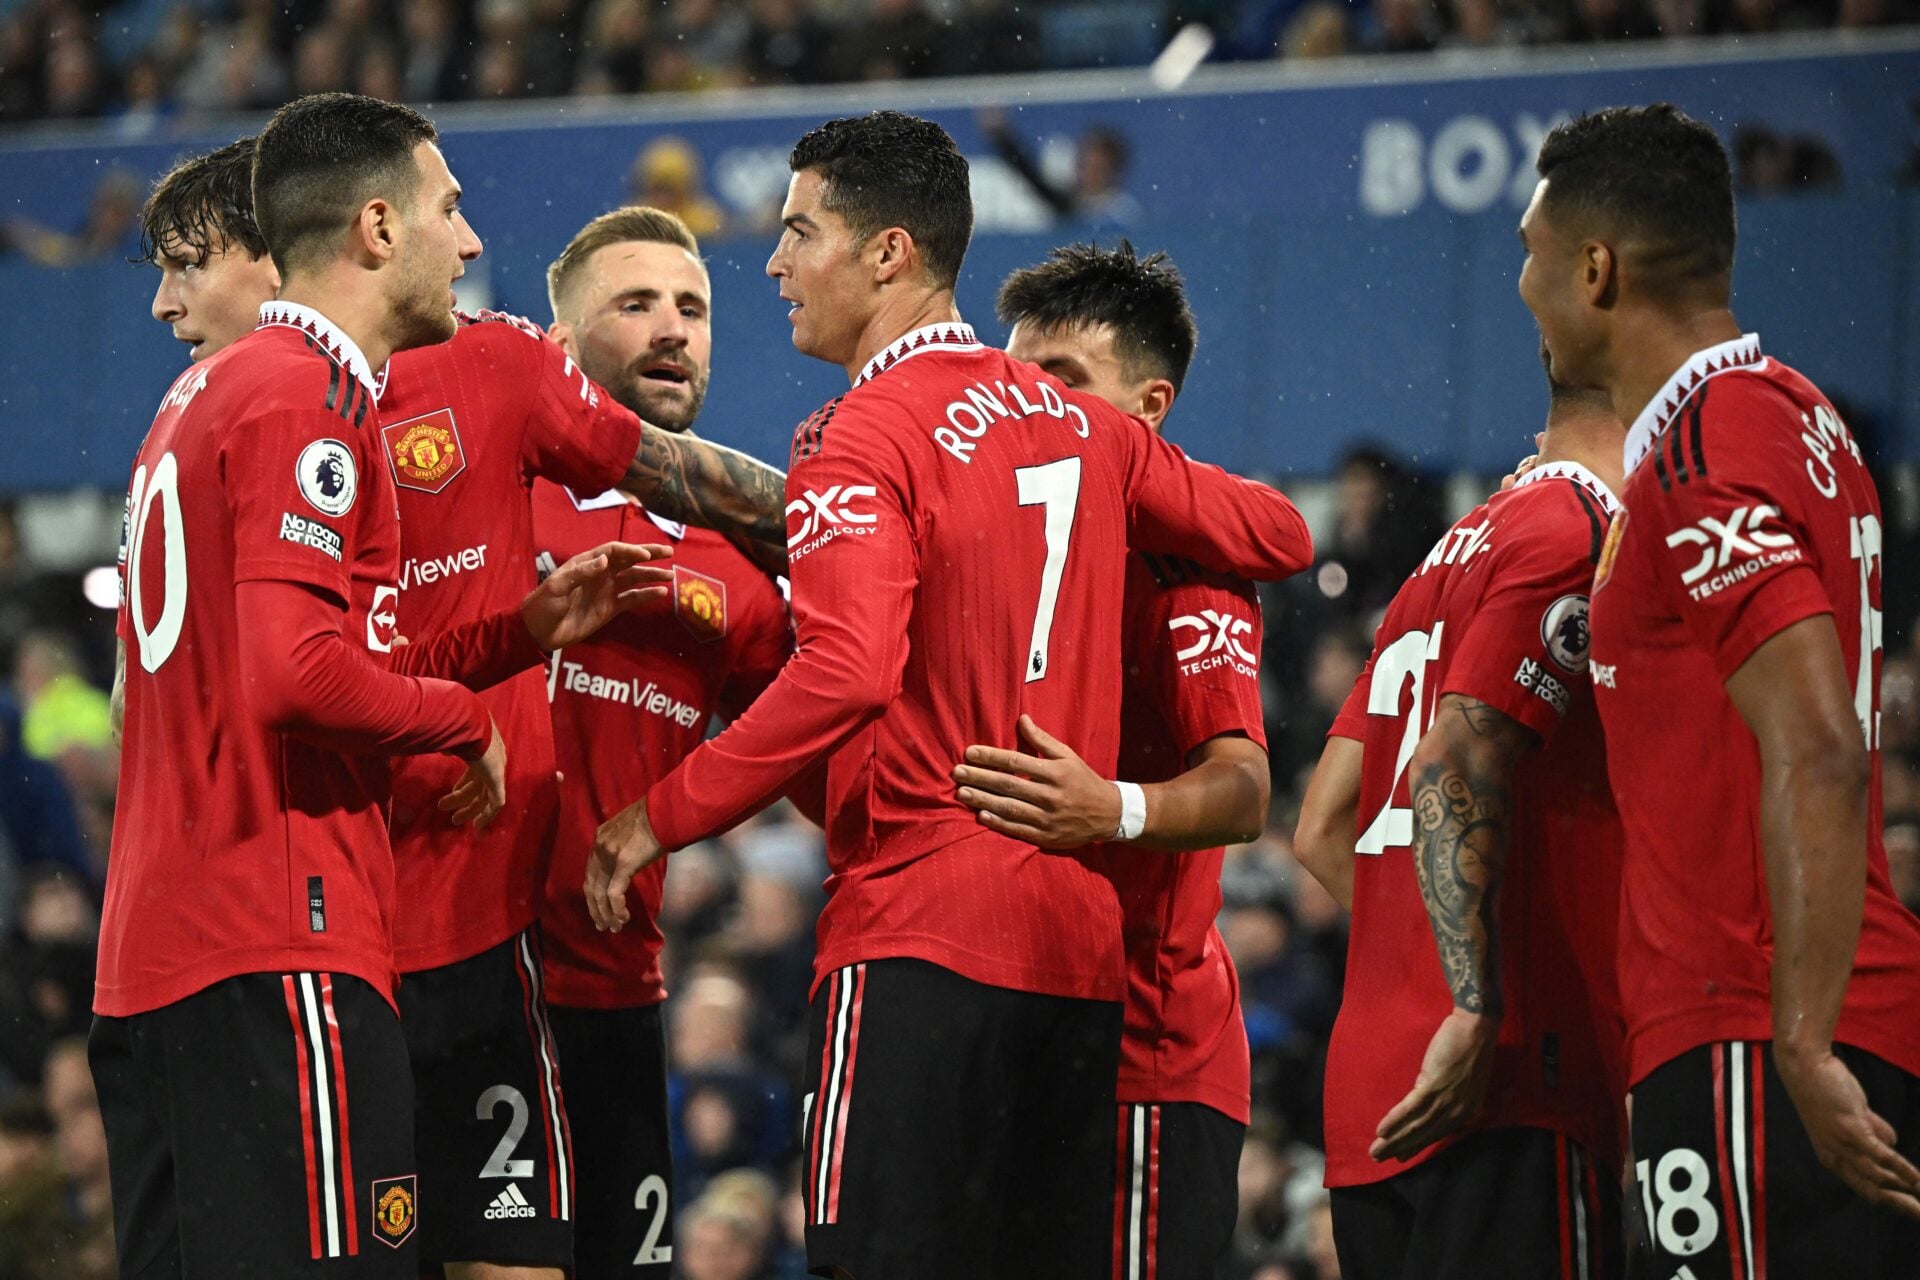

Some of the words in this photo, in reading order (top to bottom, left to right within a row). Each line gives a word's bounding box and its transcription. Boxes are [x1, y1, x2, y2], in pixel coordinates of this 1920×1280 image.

[401, 428, 446, 453] MANCHESTER
[934, 380, 1090, 464] RONLDO
[415, 463, 447, 477] UNITED
[279, 526, 306, 543] for
[282, 512, 307, 531] No
[307, 521, 341, 549] room
[785, 485, 877, 550] DXC
[788, 527, 877, 564] TECHNOLOGY
[1665, 504, 1796, 586] DXC
[1014, 455, 1082, 684] 7
[1688, 549, 1803, 603] TECHNOLOGY
[1168, 609, 1257, 665] DXC
[562, 661, 701, 729] TeamViewer
[1519, 656, 1542, 679] No
[475, 1084, 535, 1179] 2
[484, 1206, 537, 1220] adidas
[632, 1174, 673, 1265] 2
[1635, 1147, 1719, 1256] 18
